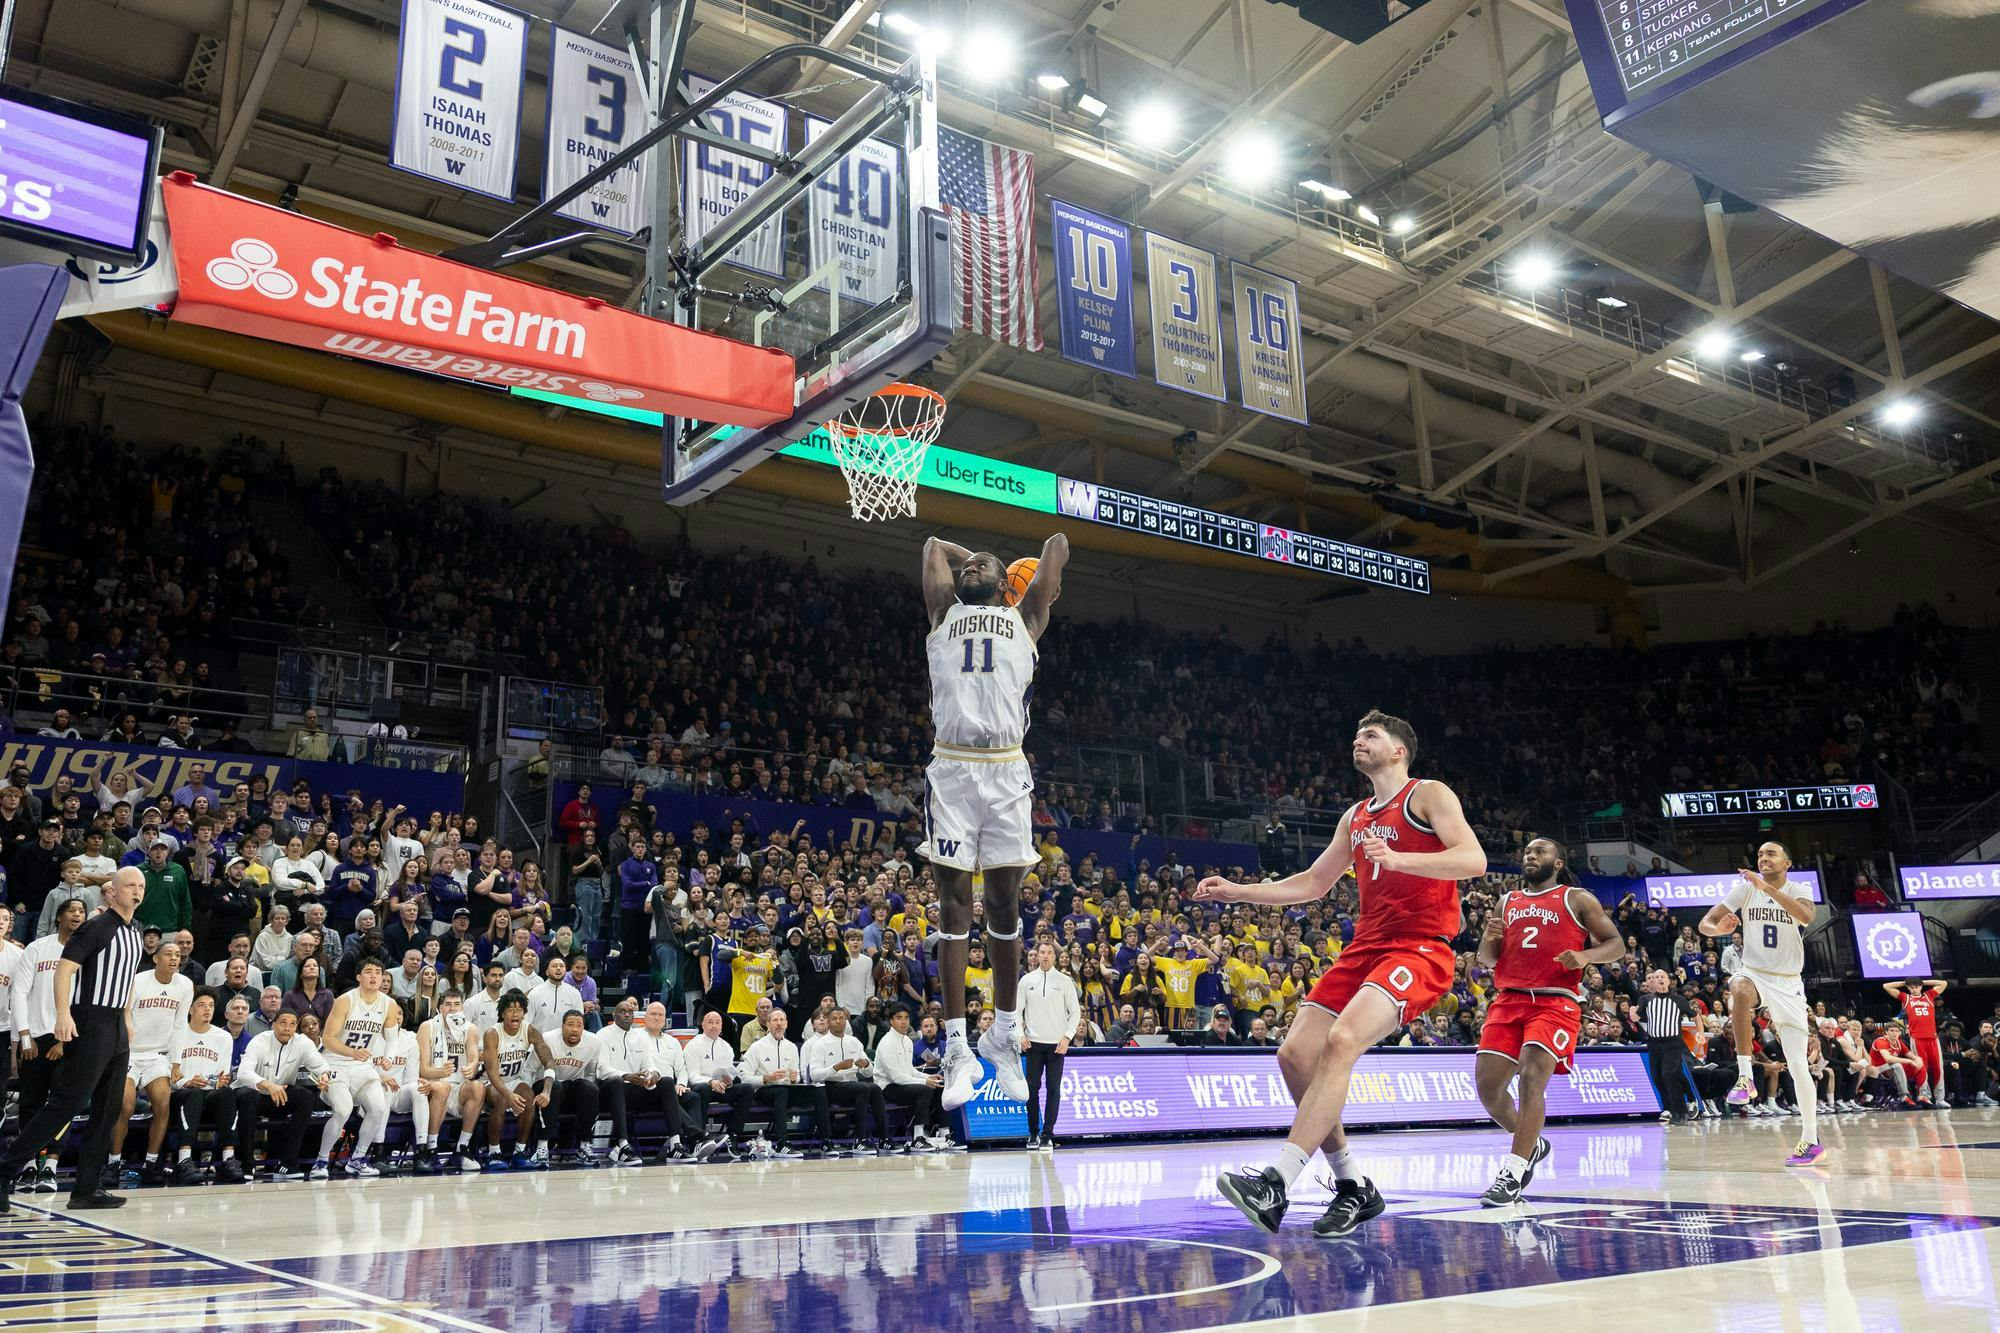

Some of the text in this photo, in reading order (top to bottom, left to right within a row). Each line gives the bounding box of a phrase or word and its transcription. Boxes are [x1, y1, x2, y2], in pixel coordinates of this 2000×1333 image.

[451, 2, 513, 30] BASKETBALL
[1619, 0, 1628, 14] 5
[1622, 18, 1631, 31] 6
[1624, 0, 1699, 48] 8 TUCKER
[1624, 13, 1712, 66] 11 KEPNANG
[1631, 6, 1764, 79] TOL 3 TEAM FOULS
[439, 15, 486, 101] 2
[566, 41, 636, 72] MEN'S BASKETB
[432, 96, 486, 125] ISAIAH
[584, 64, 627, 145] 3
[723, 96, 776, 119] BASKETBALL
[423, 113, 492, 147] THOMAS
[428, 136, 485, 162] 2008-2011
[444, 157, 466, 176] W
[588, 186, 628, 204] 02-2006
[816, 153, 891, 230] 40
[591, 201, 610, 218] W
[1057, 209, 1125, 239] WOMEN'S BASKETBALL
[821, 218, 886, 249] CHRISTIAN
[837, 240, 870, 260] WELP
[838, 259, 876, 278] 983-1987
[1068, 226, 1118, 301] 10
[846, 275, 862, 291] W
[1169, 259, 1199, 325] 3
[1078, 296, 1113, 318] KELSEY
[1083, 313, 1111, 333] PLUM
[1245, 287, 1290, 353] 16
[1080, 330, 1116, 348] 2013-2017
[1163, 322, 1211, 346] COURTNEY
[1161, 337, 1216, 362] THOMPSON
[1256, 351, 1287, 369] KRISTA
[1185, 372, 1196, 385] W
[1251, 366, 1293, 385] VANSANT
[1269, 397, 1280, 409] W
[935, 458, 1026, 495] Uber Eats
[1100, 504, 1114, 519] 50
[1122, 509, 1136, 524] 87
[1161, 503, 1178, 514] REB
[1181, 509, 1198, 518] AST
[1204, 513, 1215, 522] TO
[1143, 513, 1157, 528] 38
[1163, 518, 1177, 533] 24
[1220, 518, 1237, 527] BLK
[1240, 522, 1256, 532] STL
[1184, 523, 1197, 537] 12
[1206, 528, 1214, 541] 7
[1226, 532, 1233, 545] 6
[1245, 537, 1252, 549] 3
[1346, 547, 1361, 556] REB
[1295, 548, 1309, 562] 44
[1313, 552, 1325, 566] 87
[1331, 557, 1343, 570] 32
[1363, 551, 1378, 559] AST
[1382, 555, 1392, 563] TO
[1397, 558, 1410, 567] BLK
[1348, 560, 1360, 574] 35
[1366, 564, 1378, 577] 13
[1382, 568, 1394, 581] 10
[1414, 563, 1426, 571] STL
[1400, 572, 1407, 584] 3
[1417, 575, 1424, 588] 4
[948, 615, 1014, 640] HUSKIES
[961, 638, 994, 673] 11
[1690, 802, 1698, 813] 3
[1705, 801, 1714, 813] 9
[1723, 796, 1741, 810] 71
[1755, 799, 1782, 810] 3:06
[1796, 793, 1814, 807] 67
[1824, 796, 1832, 807] 7
[1841, 795, 1849, 806] 1
[936, 838, 961, 858] W
[1649, 880, 1725, 904] planet
[1905, 872, 1986, 895] planet
[1507, 903, 1560, 926] Buckeyes
[1748, 907, 1793, 925] HUSKIES
[1521, 926, 1539, 949] 2
[1763, 923, 1778, 949] 8
[1878, 935, 1903, 956] pf
[810, 954, 832, 972] W
[1694, 965, 1700, 975] 6
[744, 974, 764, 994] 40
[1170, 976, 1189, 993] 40
[137, 998, 180, 1011] HUSKIES
[1914, 1007, 1929, 1016] 55
[345, 1020, 382, 1034] HUSKIES
[344, 1032, 373, 1050] 23
[181, 1047, 219, 1063] HUSKIES
[499, 1060, 522, 1077] 30
[1568, 1064, 1619, 1089] planet
[1059, 1070, 1137, 1100] planet
[1186, 1074, 1258, 1109] WE'RE
[1397, 1072, 1428, 1104] ON
[1428, 1071, 1476, 1102] THIS
[1579, 1085, 1636, 1104] fitness
[1073, 1098, 1159, 1119] fitness
